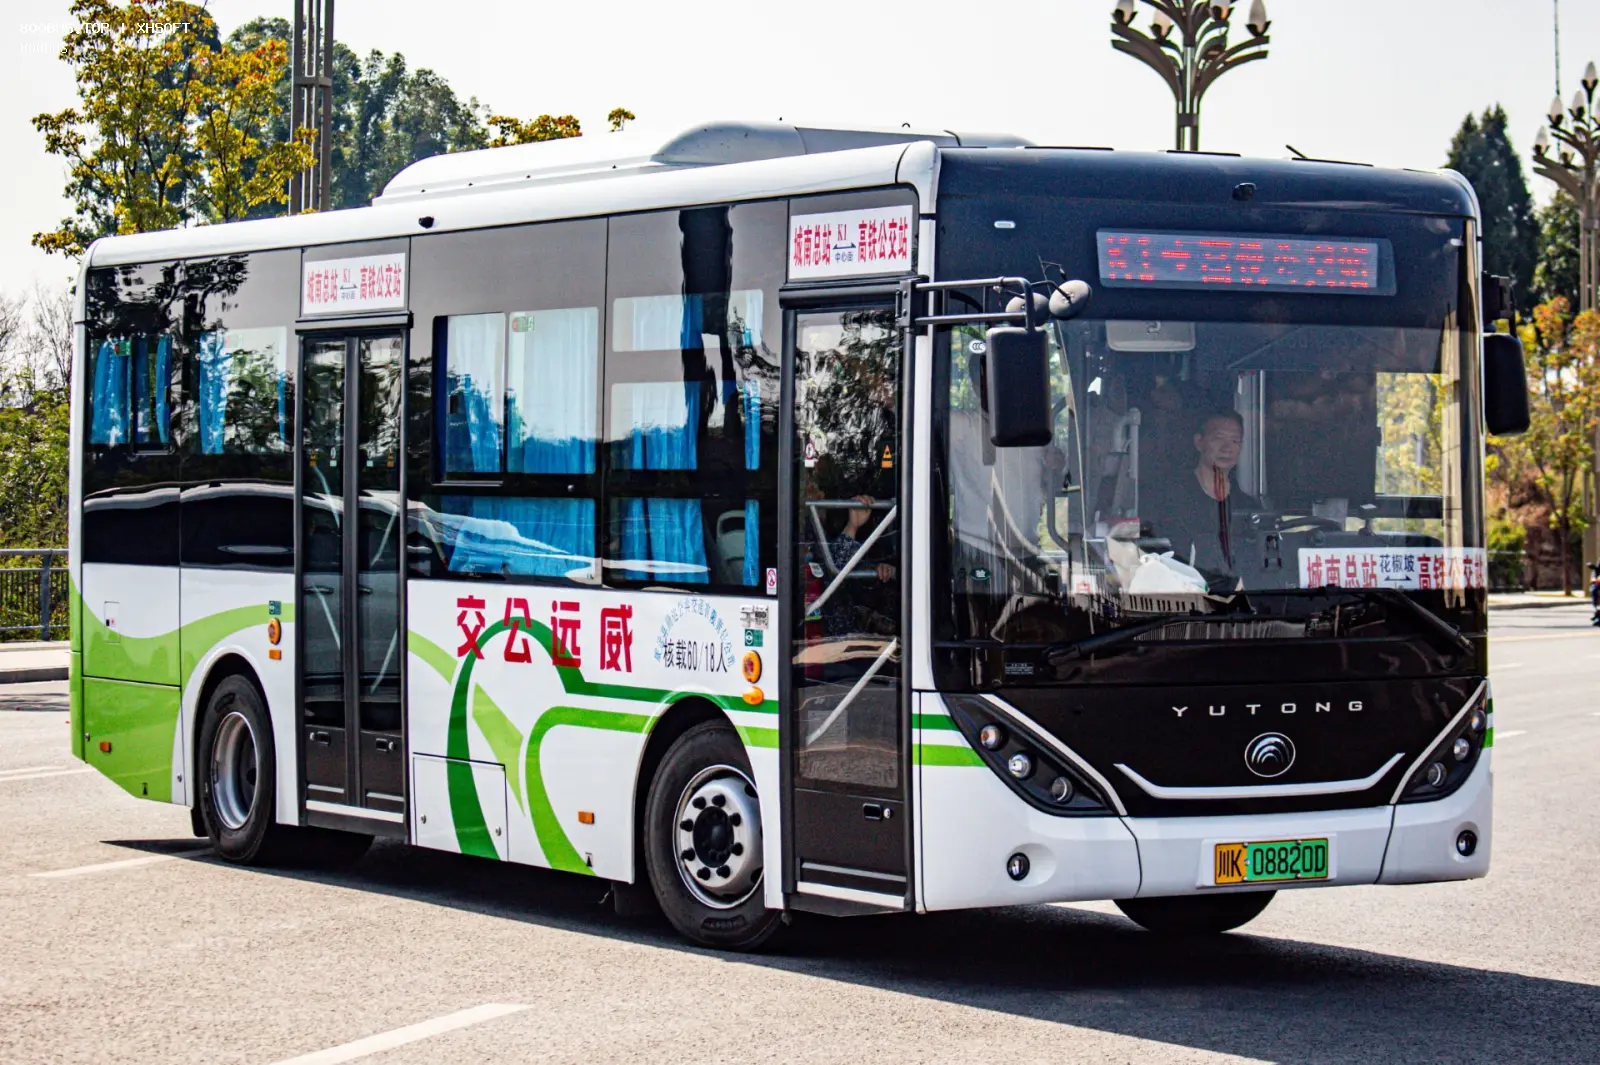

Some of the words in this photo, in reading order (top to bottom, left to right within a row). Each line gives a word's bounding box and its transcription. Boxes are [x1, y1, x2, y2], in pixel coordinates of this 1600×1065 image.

[793, 223, 832, 267] 城南总站
[858, 216, 908, 263] 高铁公交站
[306, 267, 338, 304] 城南总站
[359, 263, 402, 300] 高铁公交站
[1307, 554, 1378, 589] 城南总站
[1172, 700, 1363, 717] YUTONG
